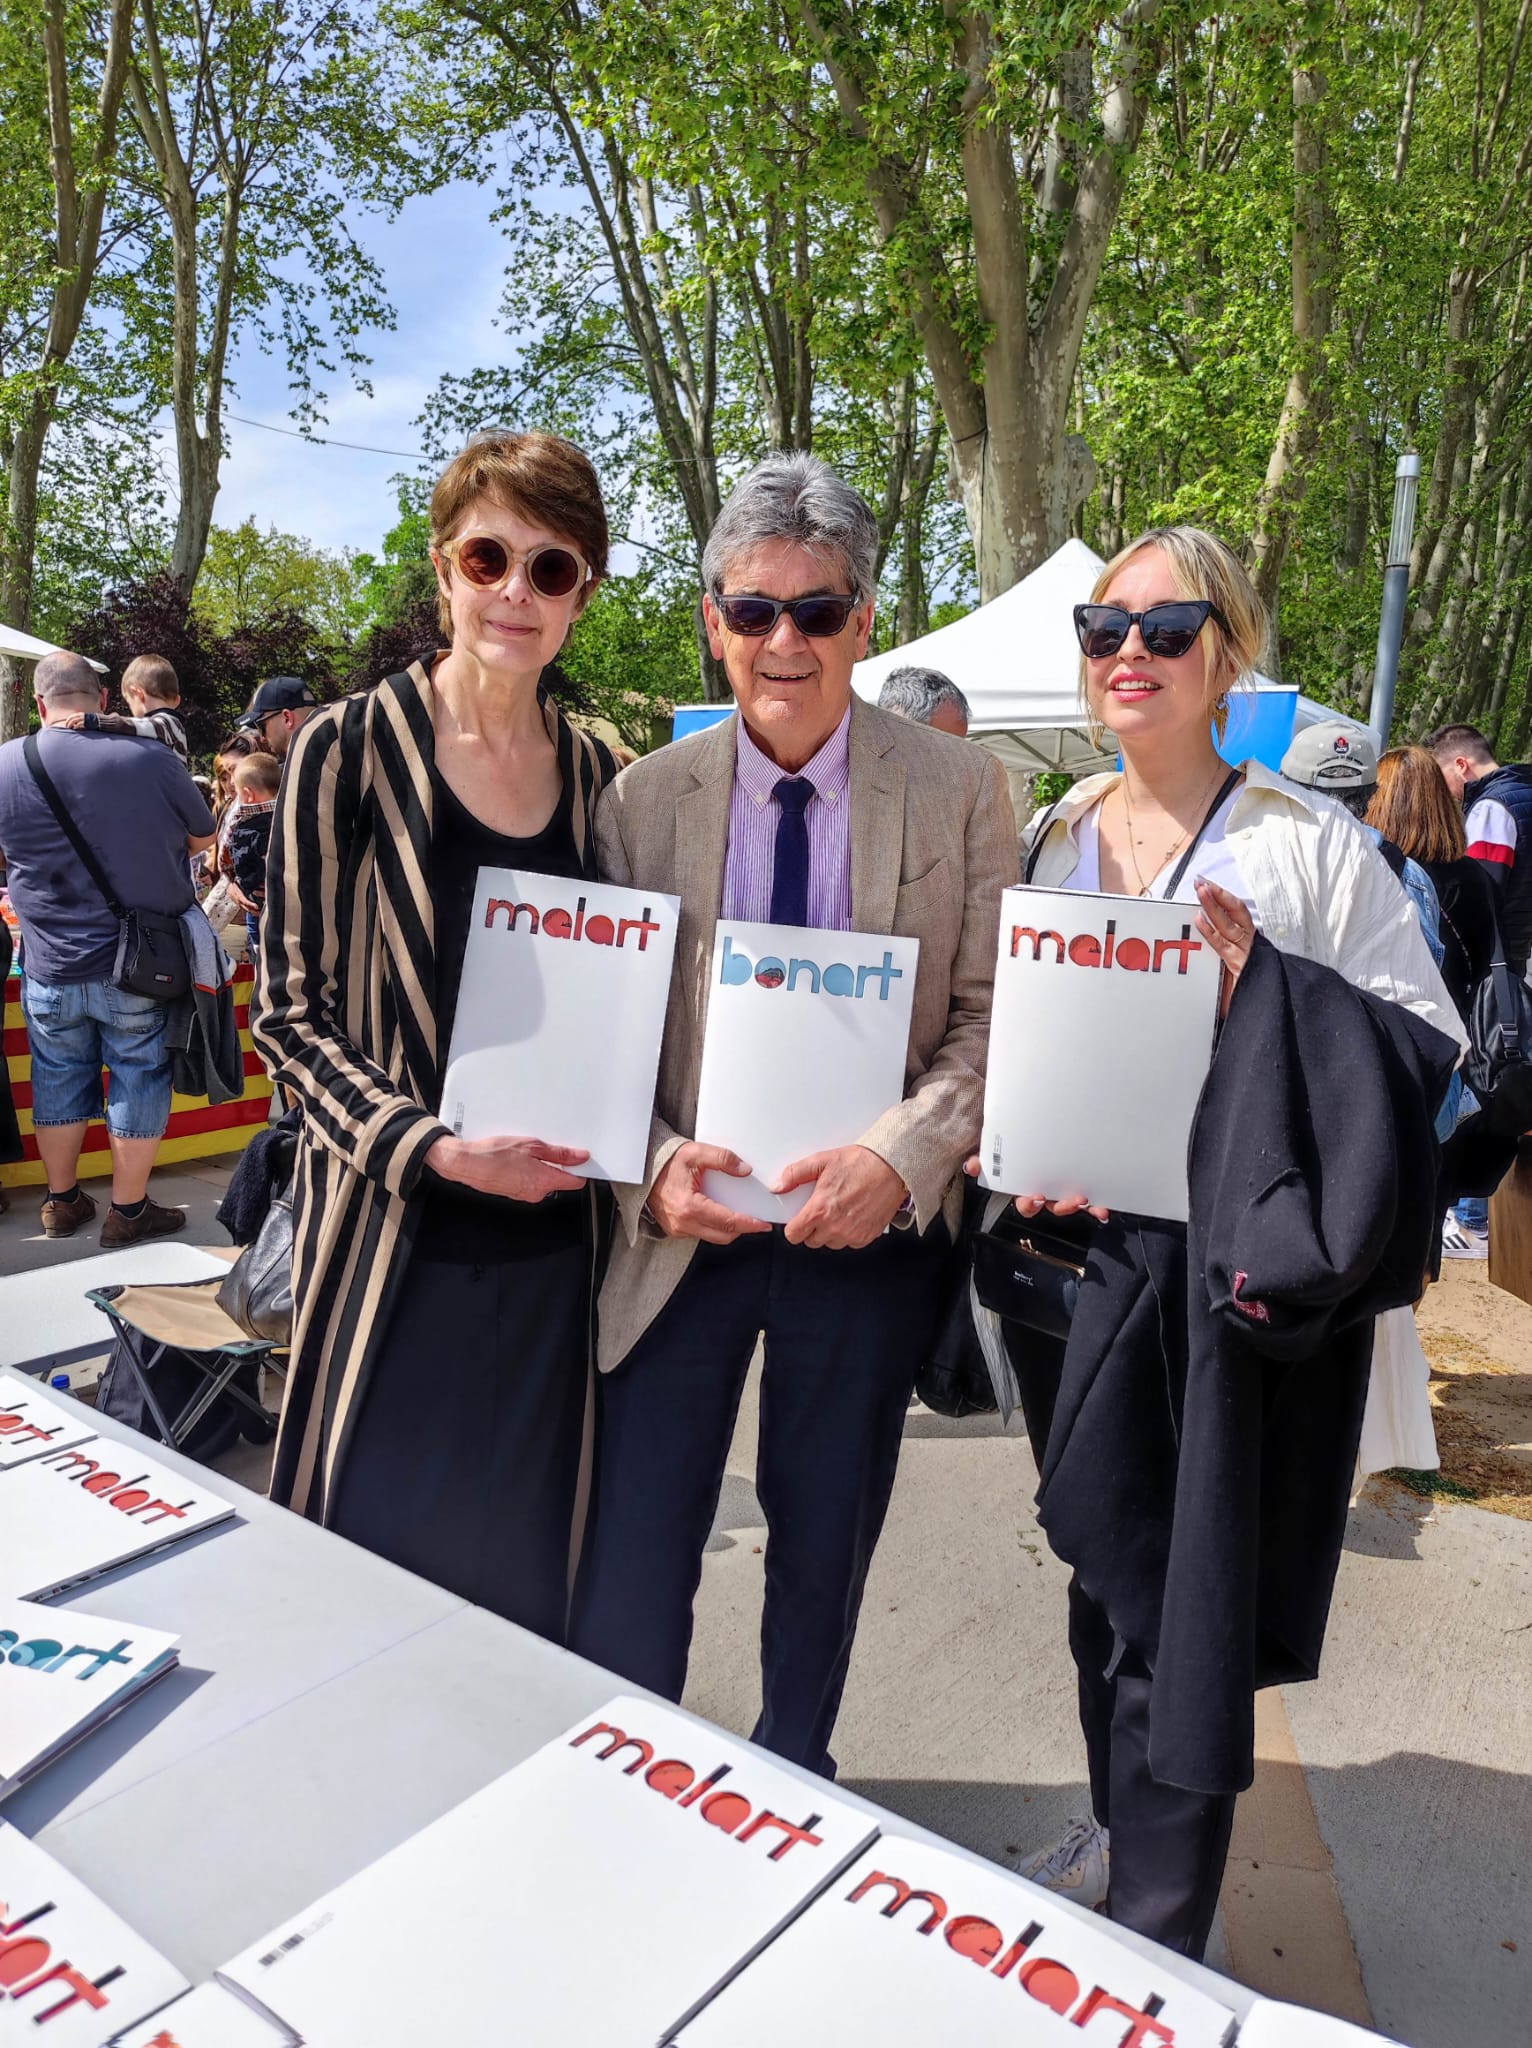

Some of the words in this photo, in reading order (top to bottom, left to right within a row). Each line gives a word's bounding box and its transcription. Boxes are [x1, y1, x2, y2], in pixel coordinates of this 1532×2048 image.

[485, 897, 660, 951] malart
[1010, 919, 1202, 975] malart
[720, 936, 903, 1000] bonart
[41, 1451, 196, 1525] malart
[568, 1722, 823, 1861] malart
[843, 1869, 1175, 2048] malart
